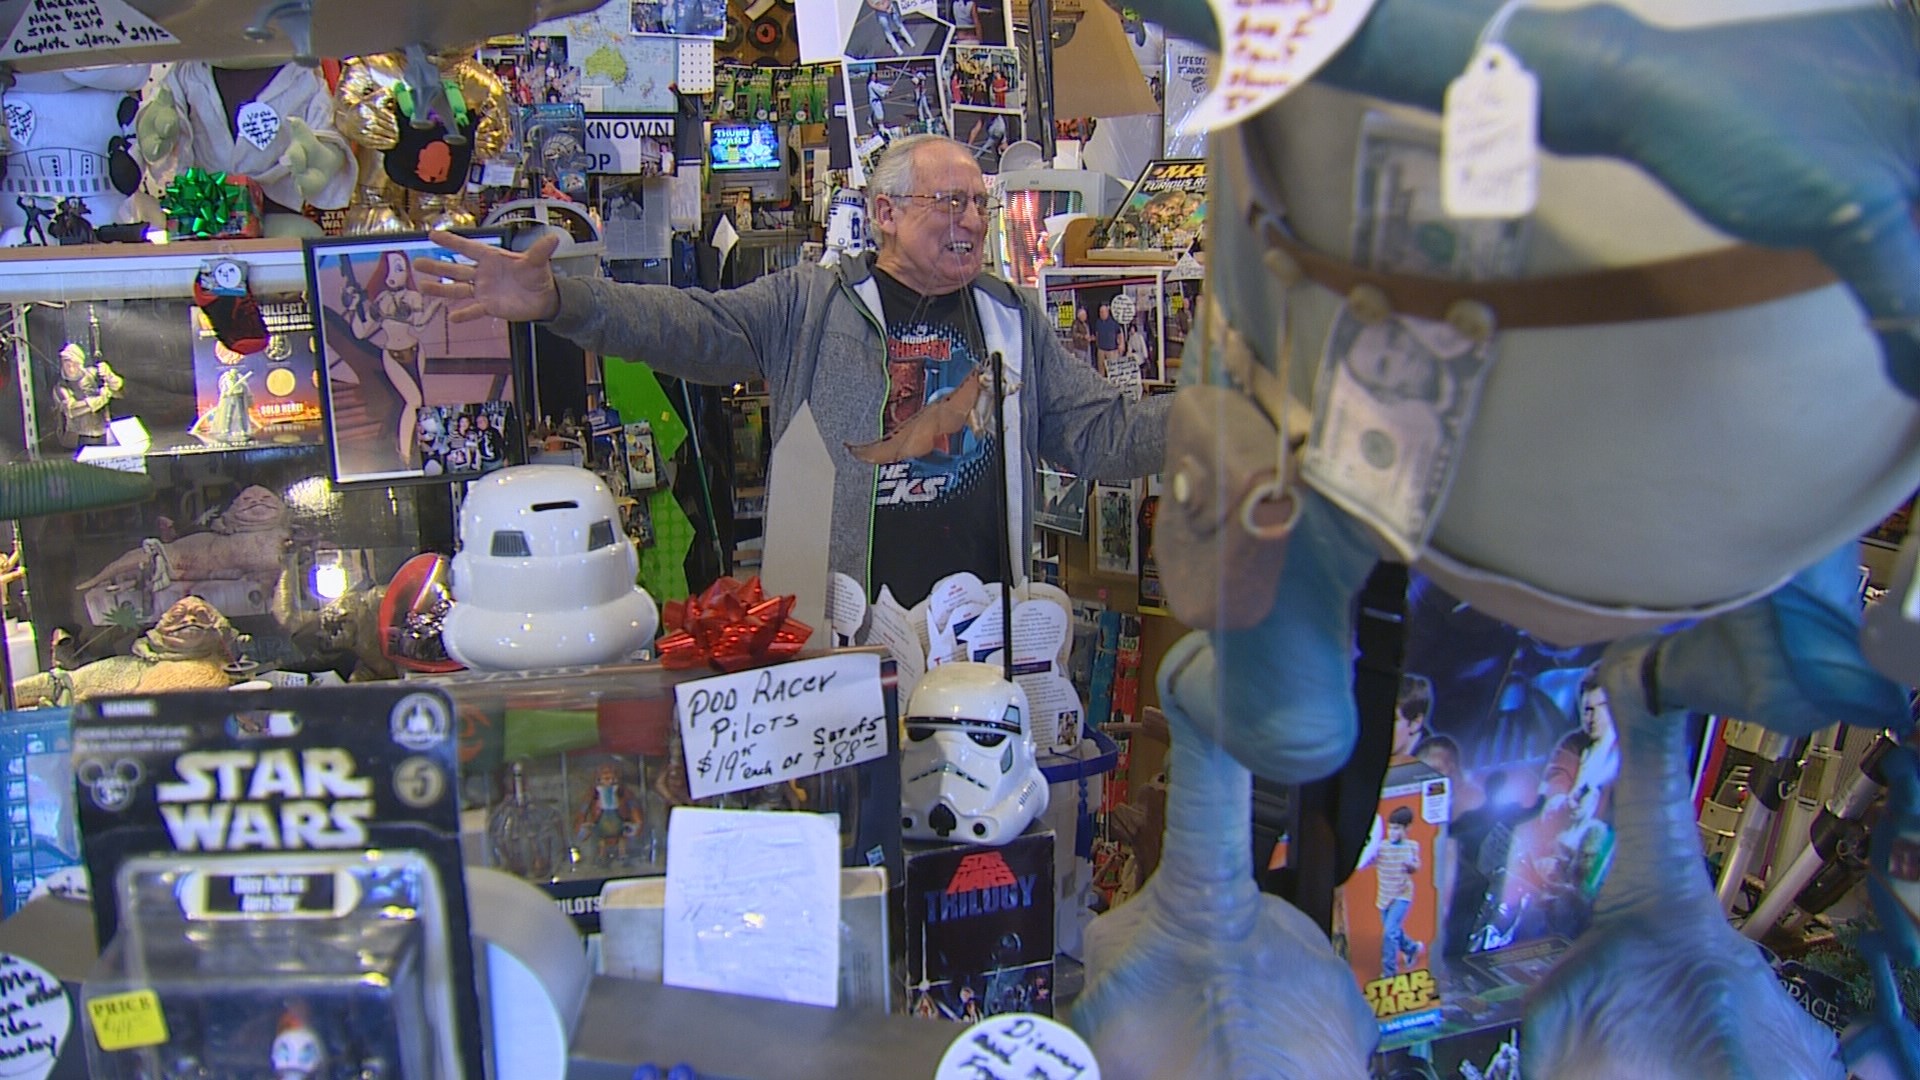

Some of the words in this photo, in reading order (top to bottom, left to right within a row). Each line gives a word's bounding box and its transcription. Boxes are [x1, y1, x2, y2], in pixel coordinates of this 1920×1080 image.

[688, 688, 738, 729] POD
[156, 749, 373, 801] STAR
[158, 799, 375, 851] WARS
[924, 873, 1038, 926] TRILOGY
[1363, 968, 1435, 1000] STAR
